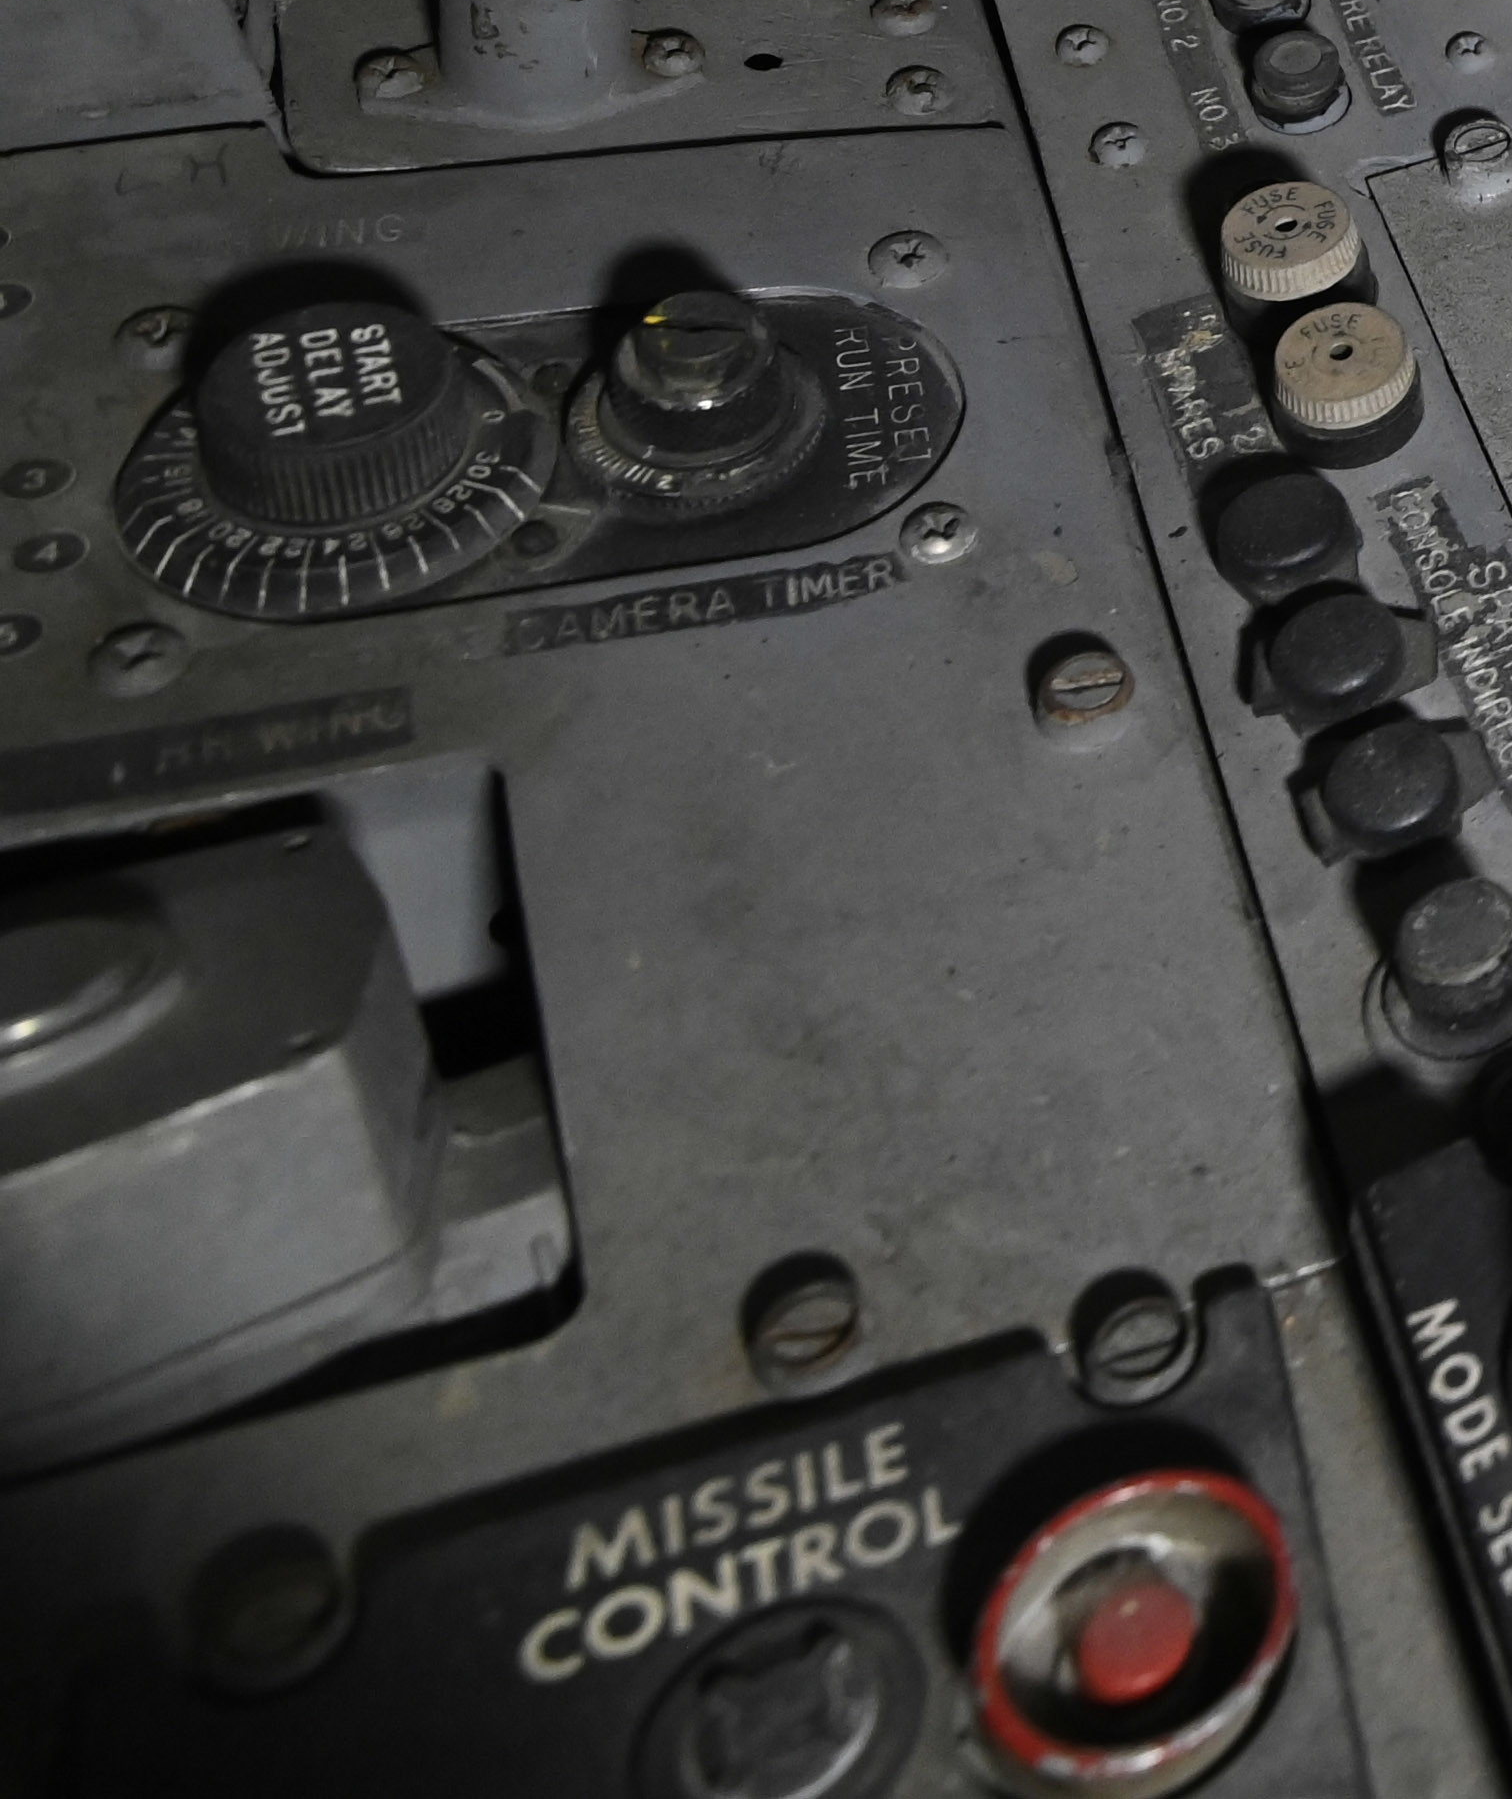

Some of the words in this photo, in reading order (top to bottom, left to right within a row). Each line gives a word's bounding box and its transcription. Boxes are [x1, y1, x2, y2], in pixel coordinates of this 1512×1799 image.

[1350, 32, 1416, 114] RELAY
[1239, 185, 1300, 219] FUSE
[1310, 199, 1339, 247] FUSE
[1233, 231, 1289, 261] FUSE
[350, 322, 404, 407] START
[832, 325, 875, 391] RUN
[1300, 312, 1364, 340] FUSE
[251, 331, 307, 438] ADJUST
[298, 327, 356, 419] DELAY
[881, 333, 933, 461] PRESET
[24, 466, 47, 489] 3
[466, 449, 500, 480] 30
[842, 407, 888, 491] TIME
[34, 541, 58, 563] 4
[517, 585, 737, 651] CAMERA
[761, 557, 896, 611] TIMER
[563, 1420, 911, 1594] MISSILE
[515, 1487, 963, 1684] CONTROL
